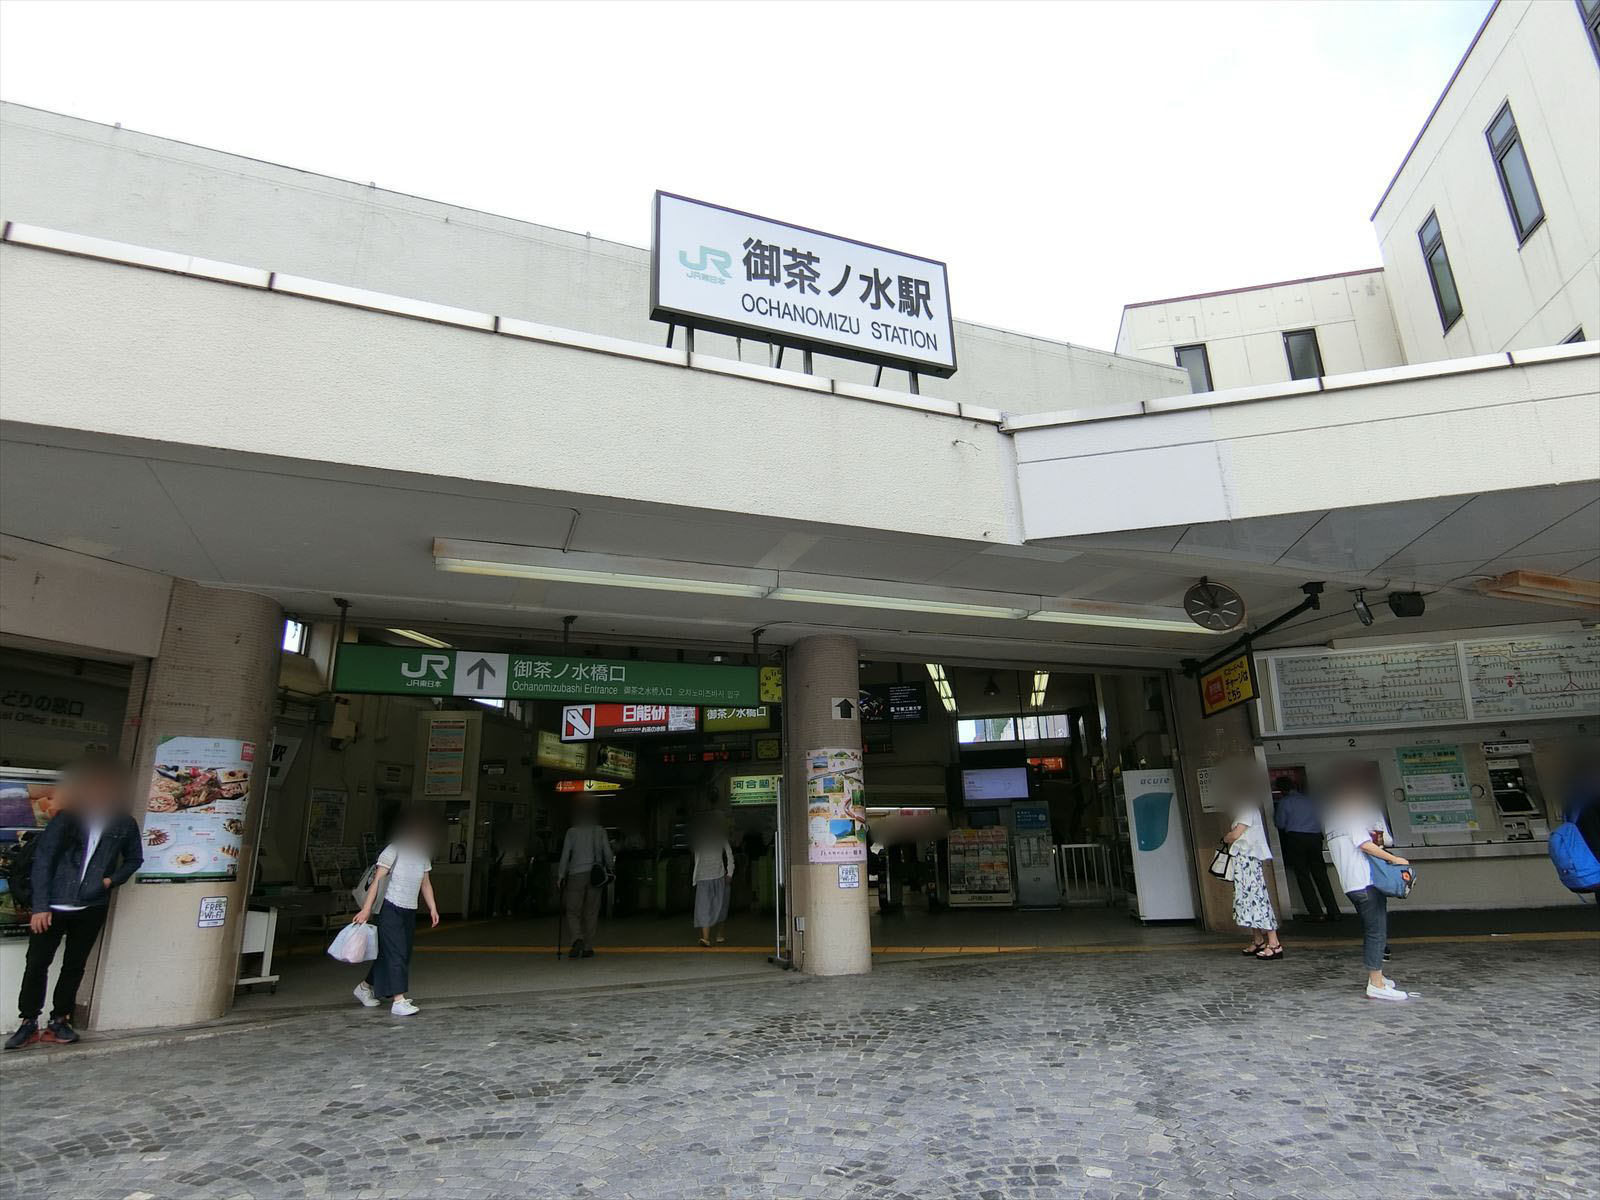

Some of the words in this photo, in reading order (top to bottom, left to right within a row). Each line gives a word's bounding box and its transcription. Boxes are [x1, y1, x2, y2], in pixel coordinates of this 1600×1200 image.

[679, 246, 733, 279] JR
[742, 237, 934, 321] 御茶ノ水駅
[741, 293, 860, 335] OCHANOMIZU
[871, 321, 938, 352] STATION
[400, 654, 450, 680] JR
[513, 660, 626, 683] 御茶ノ水橋口
[406, 680, 442, 688] JR東日本
[511, 680, 583, 694] Ochanomizubashi
[584, 684, 618, 695] Entrance
[1227, 687, 1242, 702] こちら
[622, 704, 667, 723] 日能研
[706, 706, 767, 721] 御茶ノ水橋口
[1348, 738, 1356, 747] 2
[732, 779, 770, 789] 河合塾
[1140, 777, 1170, 785] acure
[204, 903, 223, 911] FREE
[204, 911, 223, 919] Wi-Fi
